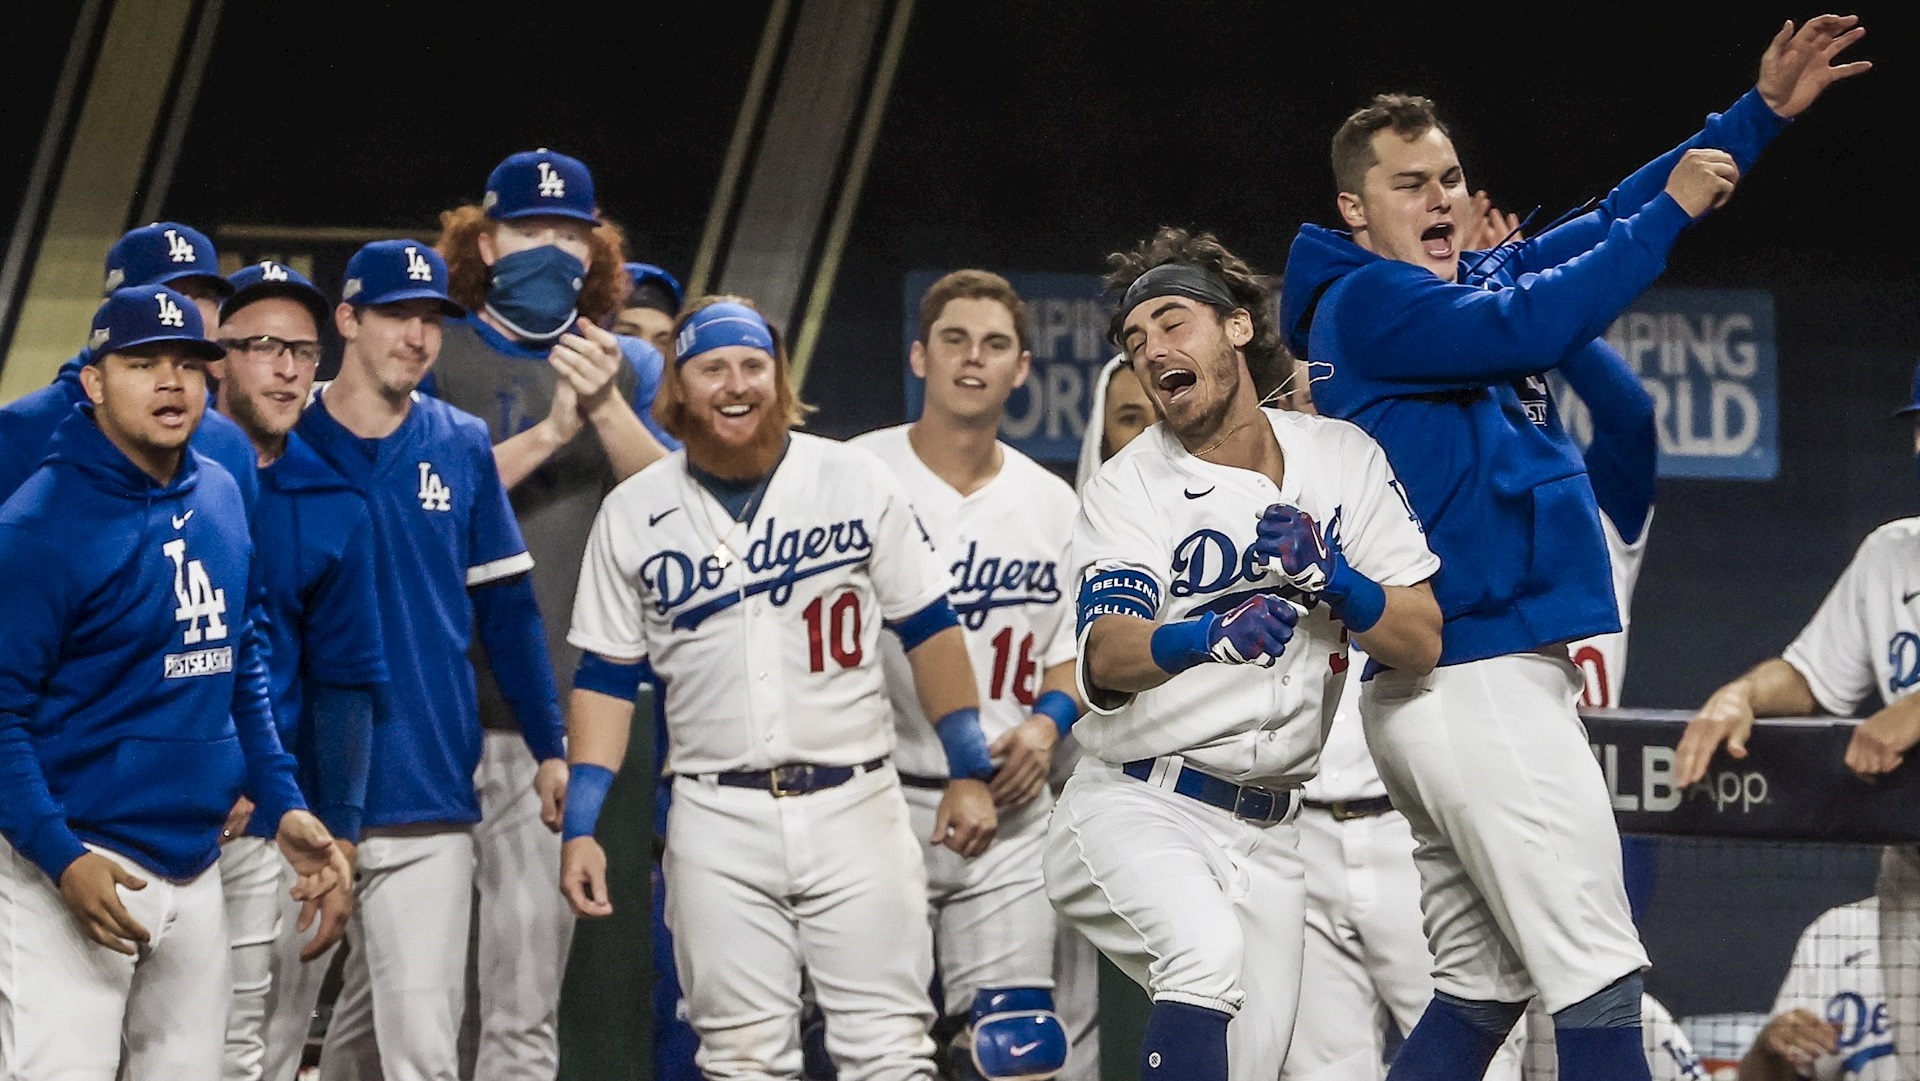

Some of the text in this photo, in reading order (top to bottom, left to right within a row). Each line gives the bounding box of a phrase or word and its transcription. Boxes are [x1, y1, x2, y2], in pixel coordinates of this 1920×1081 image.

[537, 162, 565, 198] LA
[164, 229, 196, 262] LA
[405, 247, 432, 282] LA
[155, 292, 185, 327] LA
[418, 462, 451, 511] LA
[163, 538, 227, 645] LA
[640, 516, 873, 616] Dodgers
[802, 591, 863, 673] 10
[990, 626, 1036, 706] 16
[1591, 743, 1683, 812] LB
